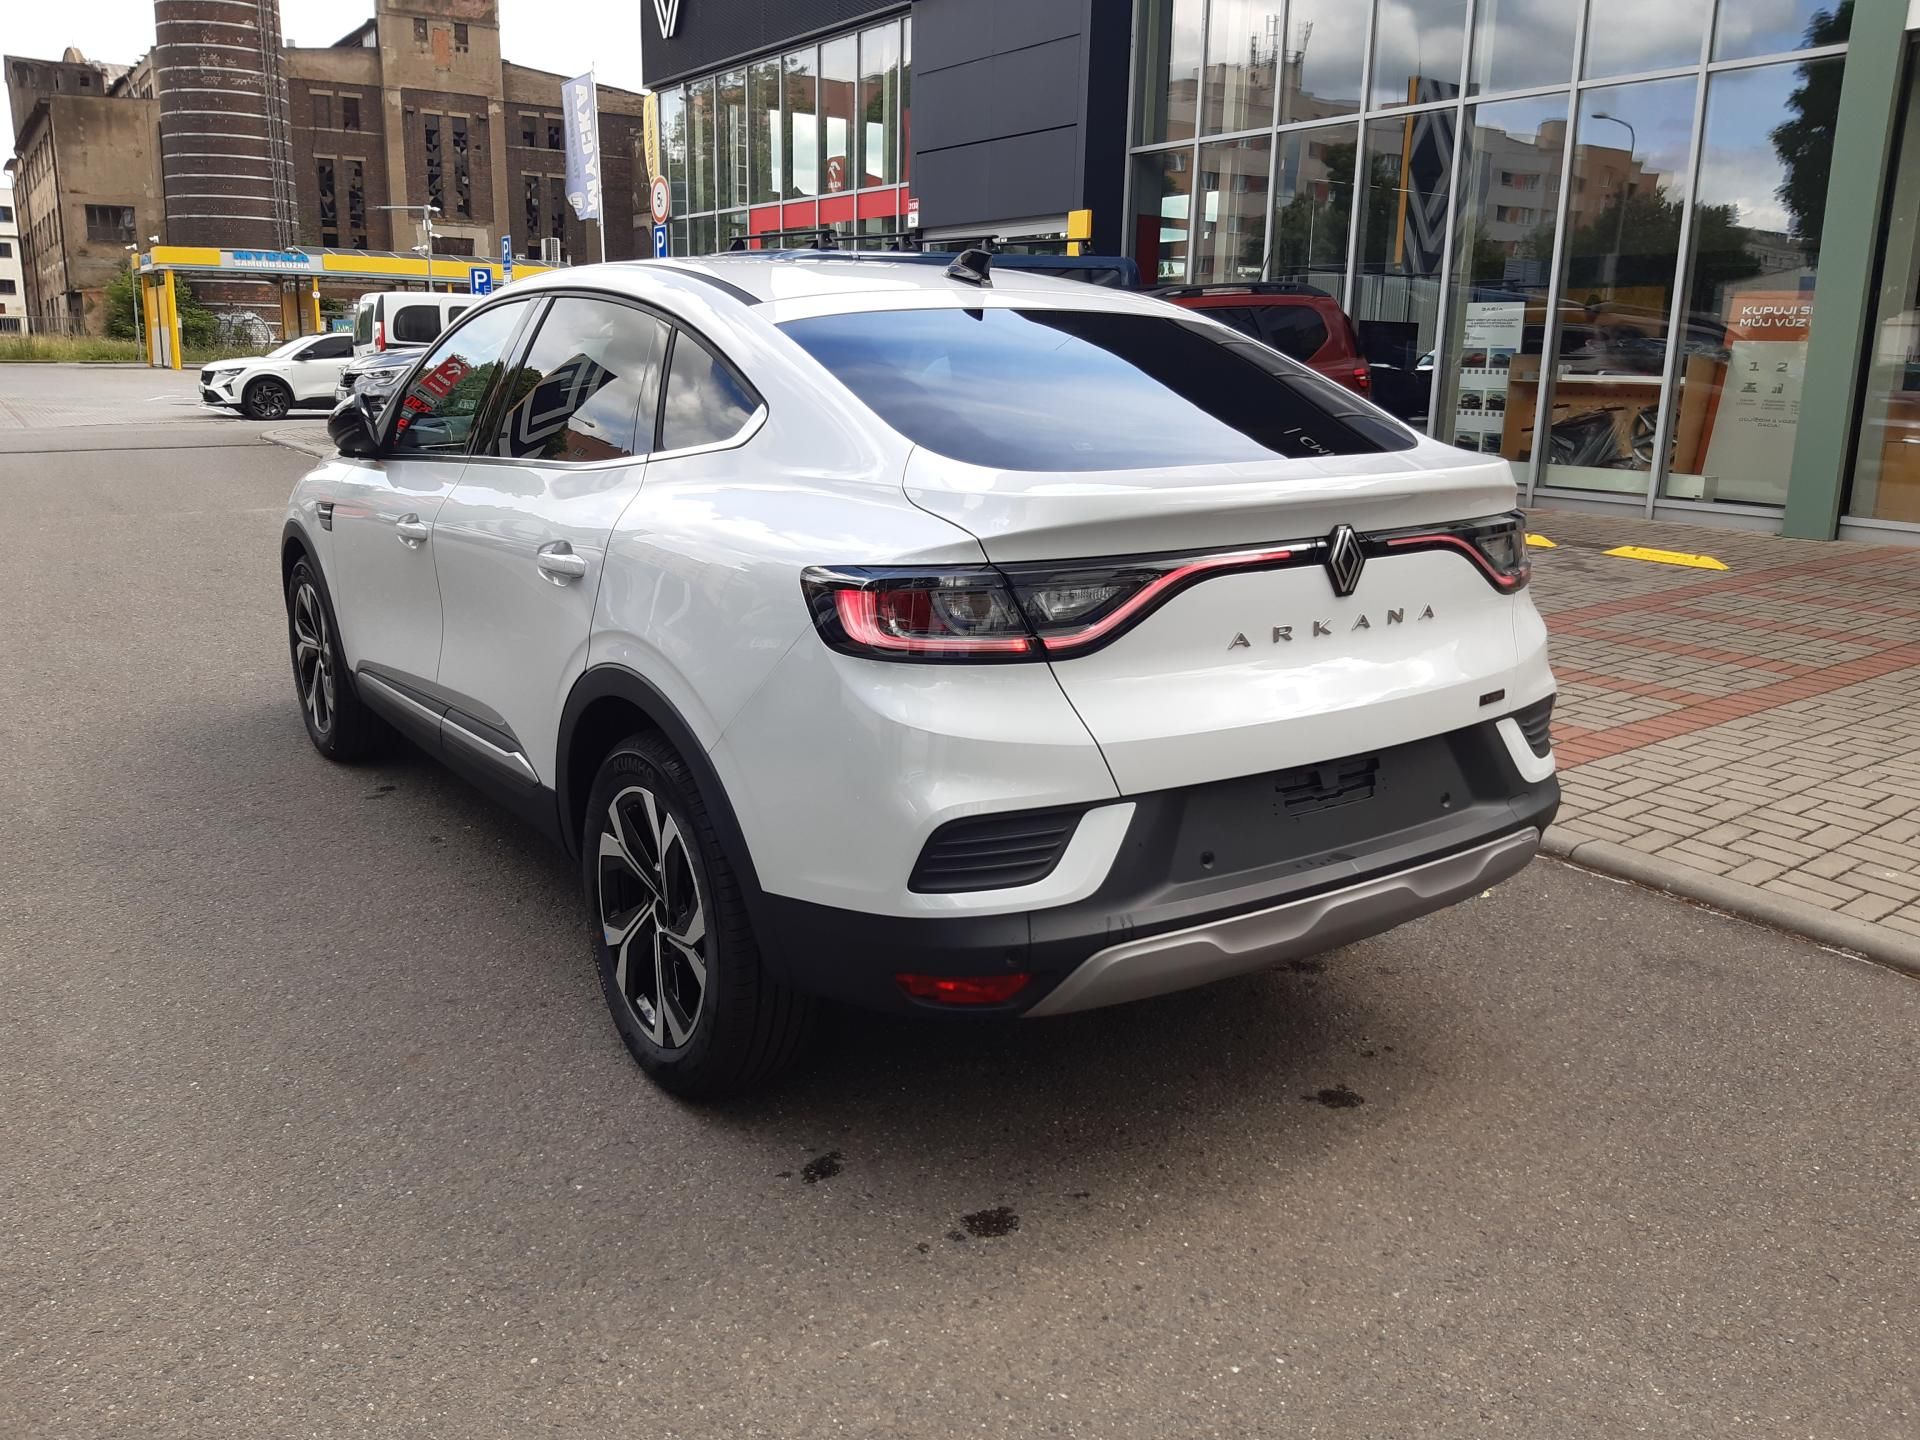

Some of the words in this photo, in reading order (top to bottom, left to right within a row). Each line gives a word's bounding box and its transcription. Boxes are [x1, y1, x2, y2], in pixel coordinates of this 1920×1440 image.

[656, 231, 664, 258] P
[474, 270, 488, 290] P
[1741, 306, 1797, 315] KUPUJI
[1739, 315, 1772, 327] MŮJ
[1775, 315, 1807, 327] VŮZ
[1749, 362, 1760, 371] 1
[1776, 362, 1788, 372] 2
[1228, 602, 1435, 650] ARKANA
